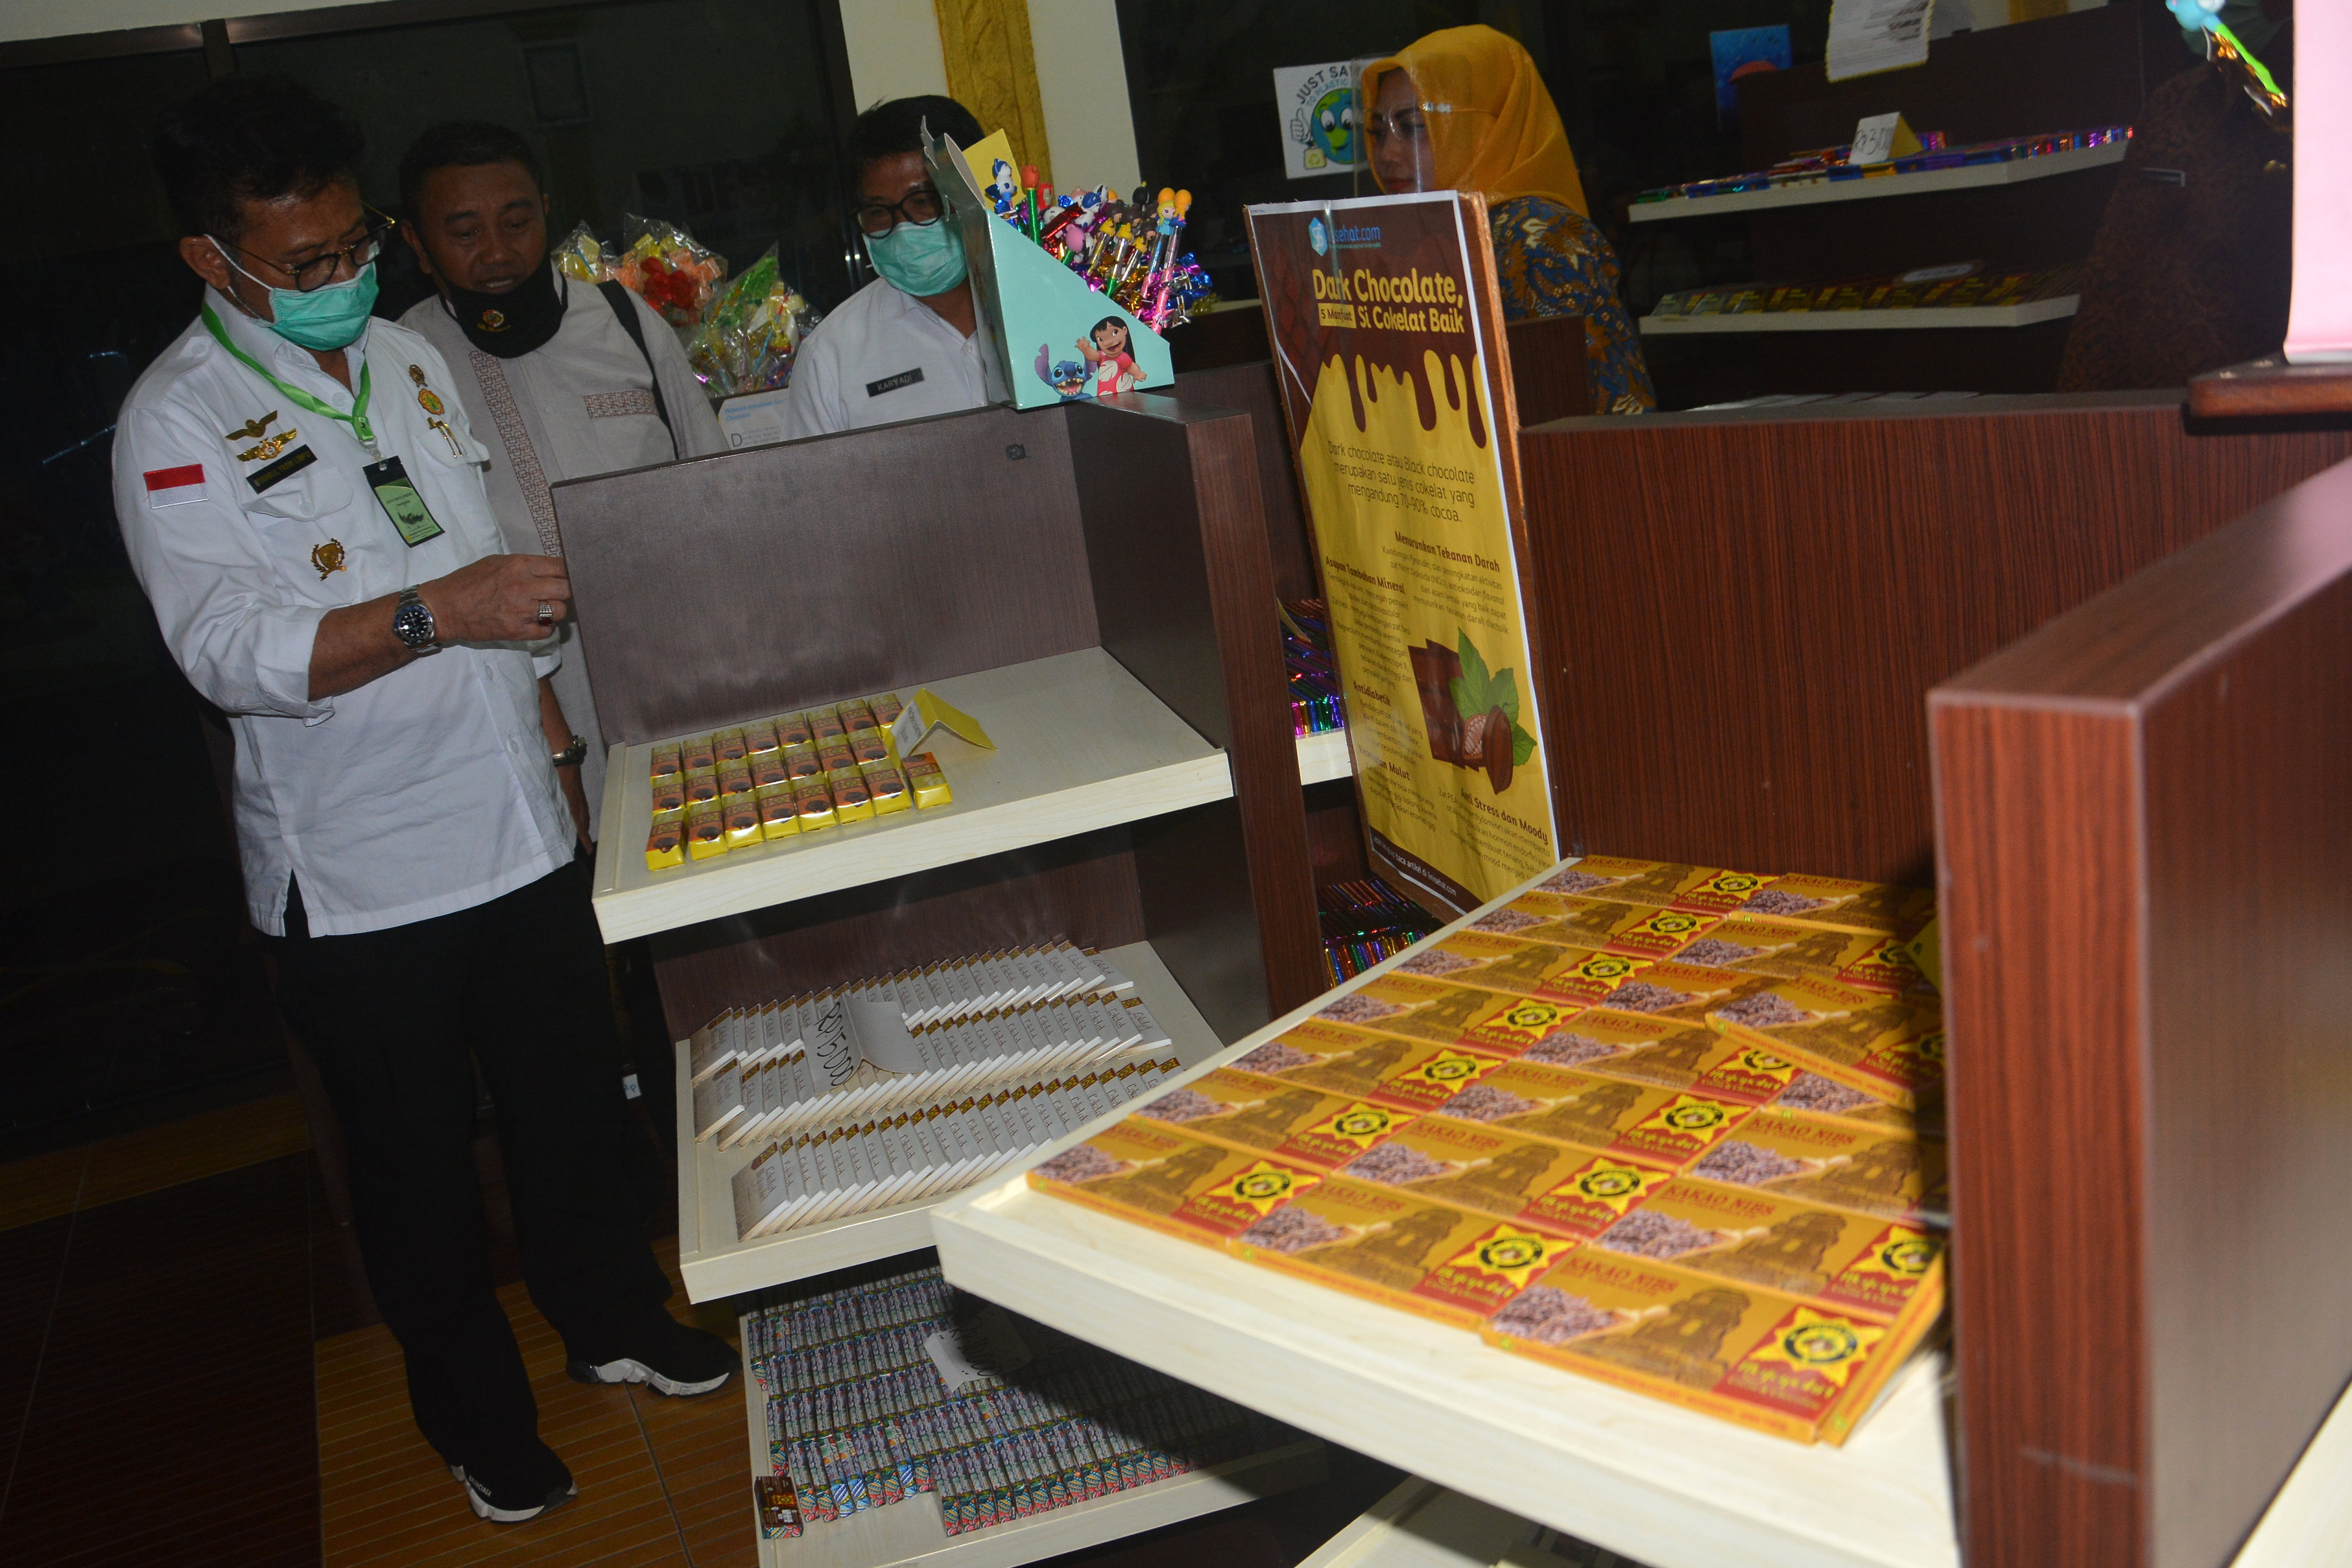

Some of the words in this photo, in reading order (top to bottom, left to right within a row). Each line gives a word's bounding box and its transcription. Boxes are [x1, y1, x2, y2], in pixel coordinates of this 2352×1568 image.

[1296, 70, 1325, 104] JUST
[1313, 269, 1352, 301] Dark
[1353, 267, 1464, 308] Chocolate,
[1328, 308, 1352, 323] Manfaat
[1357, 306, 1371, 328] Si
[1372, 306, 1427, 332] Cokelat
[1429, 308, 1465, 333] Baik
[877, 375, 914, 392] KARYADI
[1328, 441, 1345, 456] Dark
[1348, 445, 1384, 464] chocolate
[1387, 455, 1403, 469] atau
[1405, 457, 1425, 475] Black
[1427, 463, 1475, 484] chocolate
[1334, 462, 1376, 480] merupakan
[1378, 471, 1396, 485] satu
[1398, 473, 1413, 490] jenis
[1415, 481, 1447, 500] cokelat
[1449, 490, 1475, 508] yang
[1348, 483, 1399, 508] mengandung
[1400, 493, 1428, 514] 70-90%
[1430, 505, 1462, 522] cocoa.
[1395, 531, 1436, 555] Menurunkan
[1436, 545, 1473, 564] Tekanan
[1474, 554, 1500, 572] Darah
[1326, 556, 1346, 572] Asupan
[1346, 563, 1376, 586] Tambahan
[1377, 576, 1405, 594] Mineral
[1460, 599, 1477, 612] yang
[1467, 614, 1485, 626] darah
[1353, 680, 1391, 707] Antidiabetik
[1388, 762, 1410, 781] Mulut
[1461, 787, 1473, 806] Anti
[1474, 797, 1499, 818] Stress
[1501, 810, 1517, 826] dan
[1519, 818, 1548, 845] Moody
[1489, 830, 1513, 849] hormon
[1518, 835, 1550, 857] membantu
[1395, 852, 1406, 866] baca
[1407, 861, 1421, 874] artikel
[1422, 869, 1427, 877] di
[1484, 854, 1500, 868] mood
[1134, 1012, 1154, 1030] Cokelat
[1661, 1185, 1728, 1205] KAKAO
